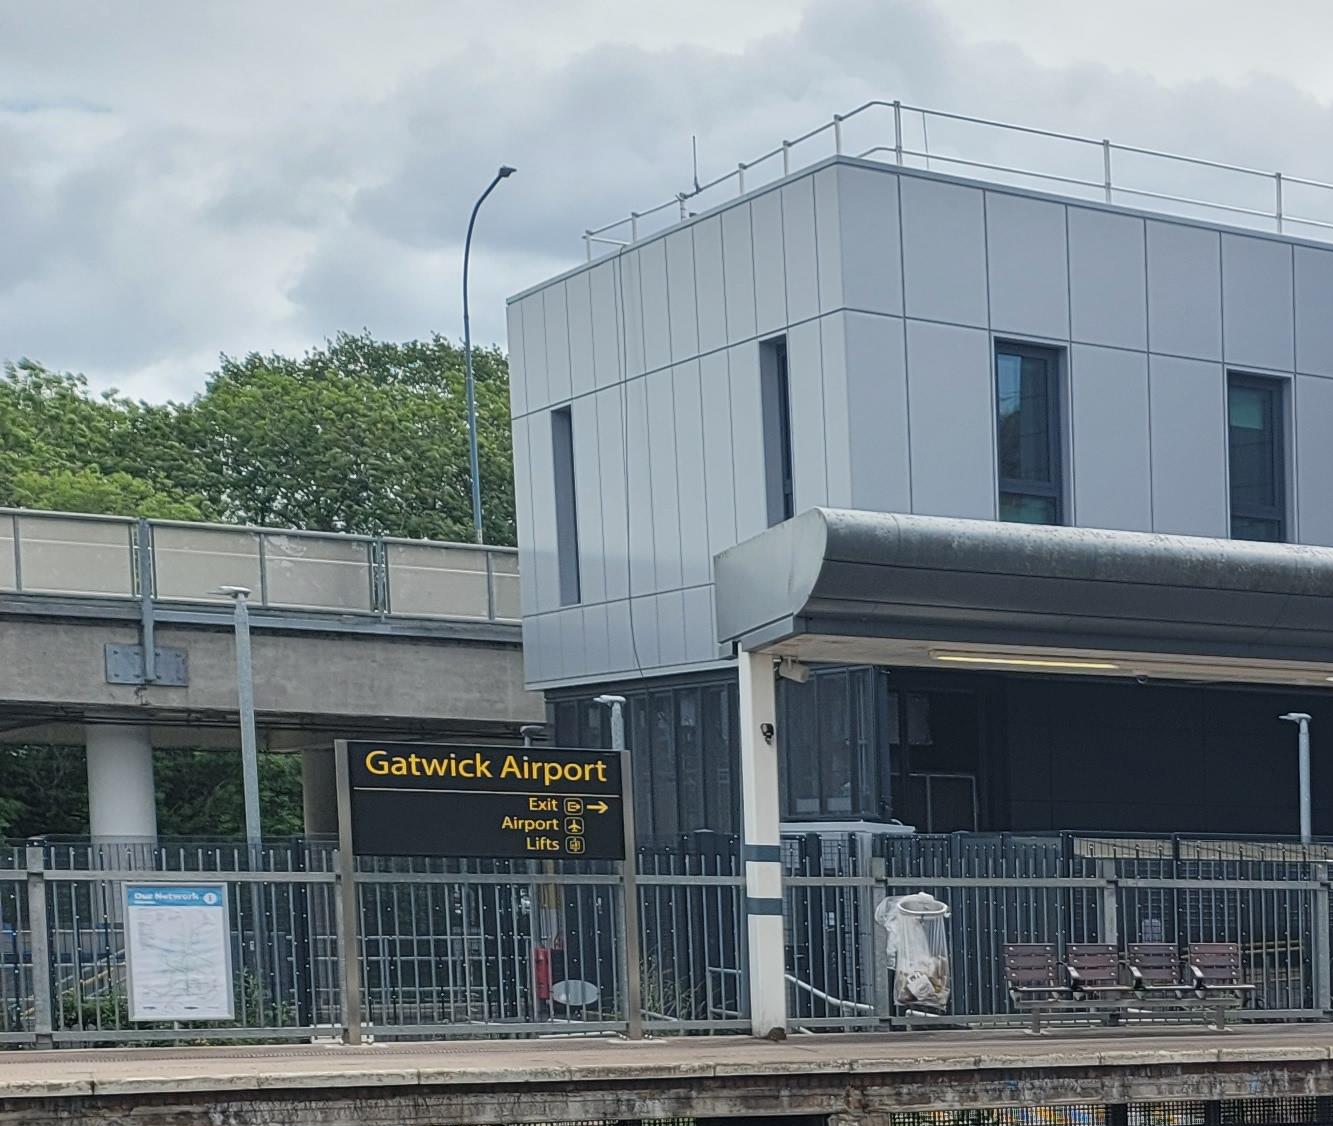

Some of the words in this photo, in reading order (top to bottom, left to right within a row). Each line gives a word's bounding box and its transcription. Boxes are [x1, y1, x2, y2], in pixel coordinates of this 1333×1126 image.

[364, 749, 493, 779] Gatwick
[499, 754, 607, 786] Airport
[528, 797, 558, 812] Exit
[501, 816, 559, 832] Airport
[526, 836, 560, 851] Lifts
[155, 892, 199, 900] Network
